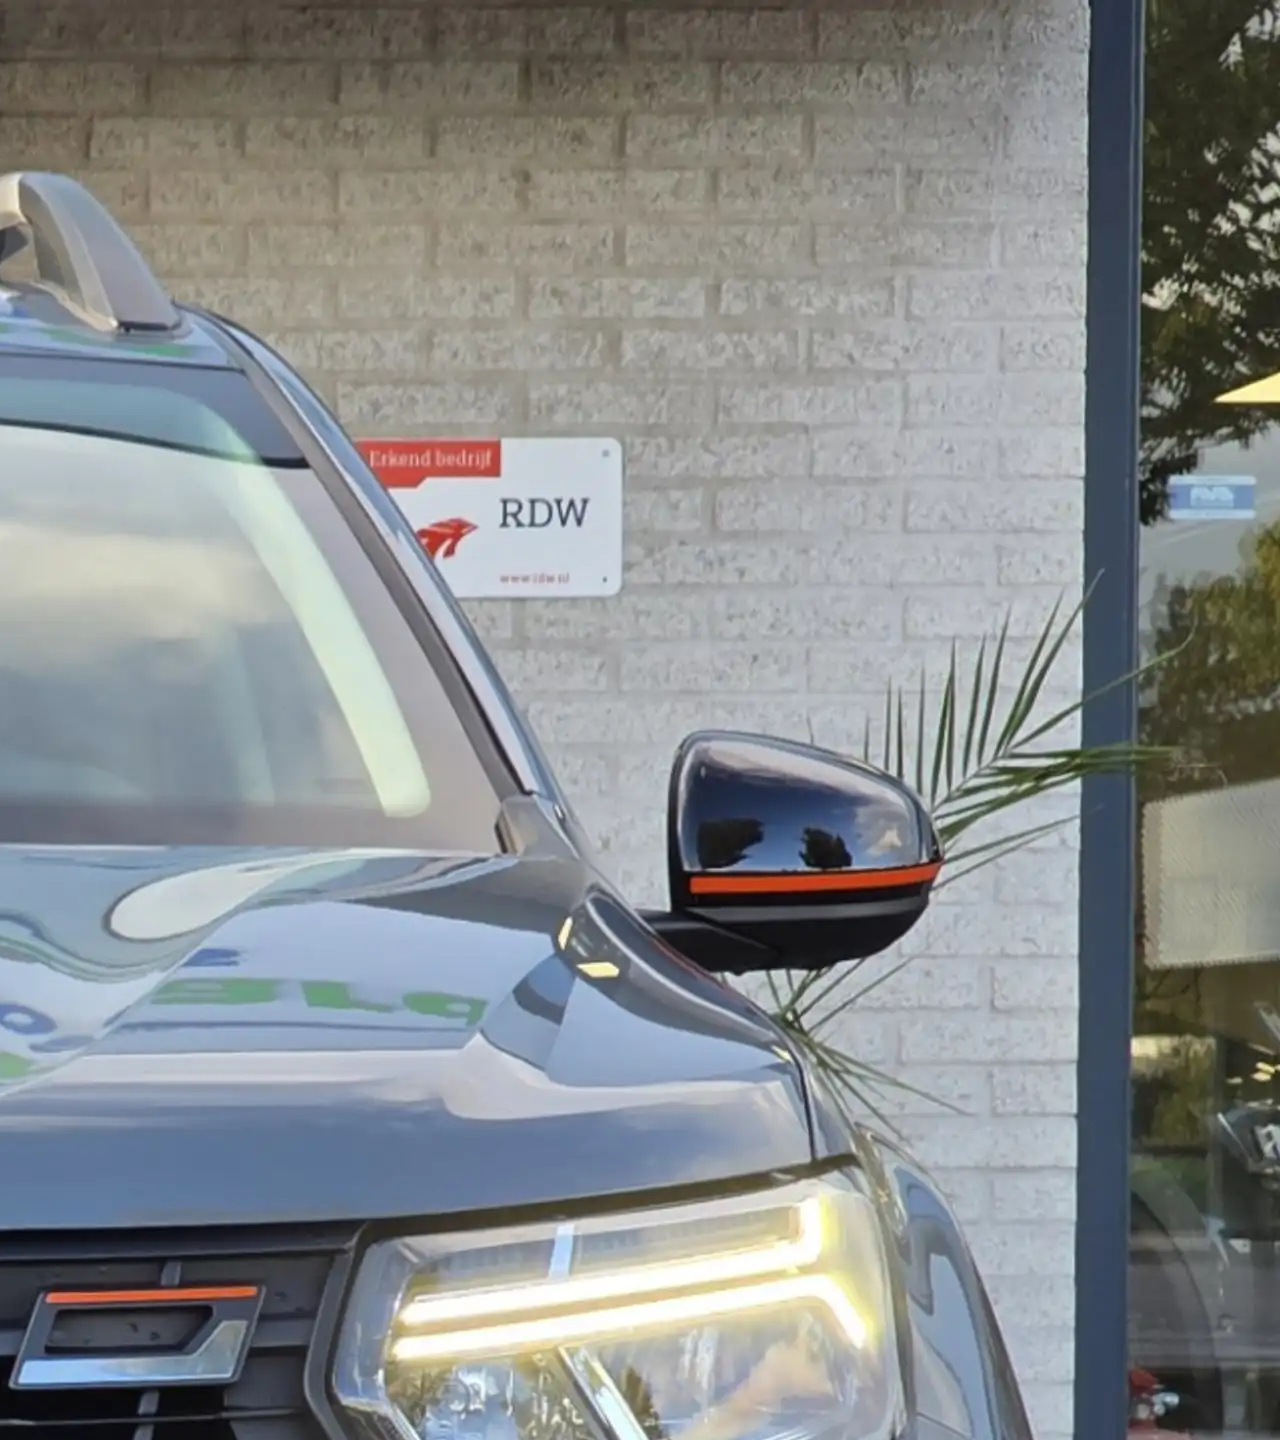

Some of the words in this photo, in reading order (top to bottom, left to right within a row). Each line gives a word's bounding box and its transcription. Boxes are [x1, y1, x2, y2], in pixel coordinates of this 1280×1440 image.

[369, 449, 431, 468] Erkend
[435, 448, 493, 470] bedrijf
[499, 497, 590, 528] RDW
